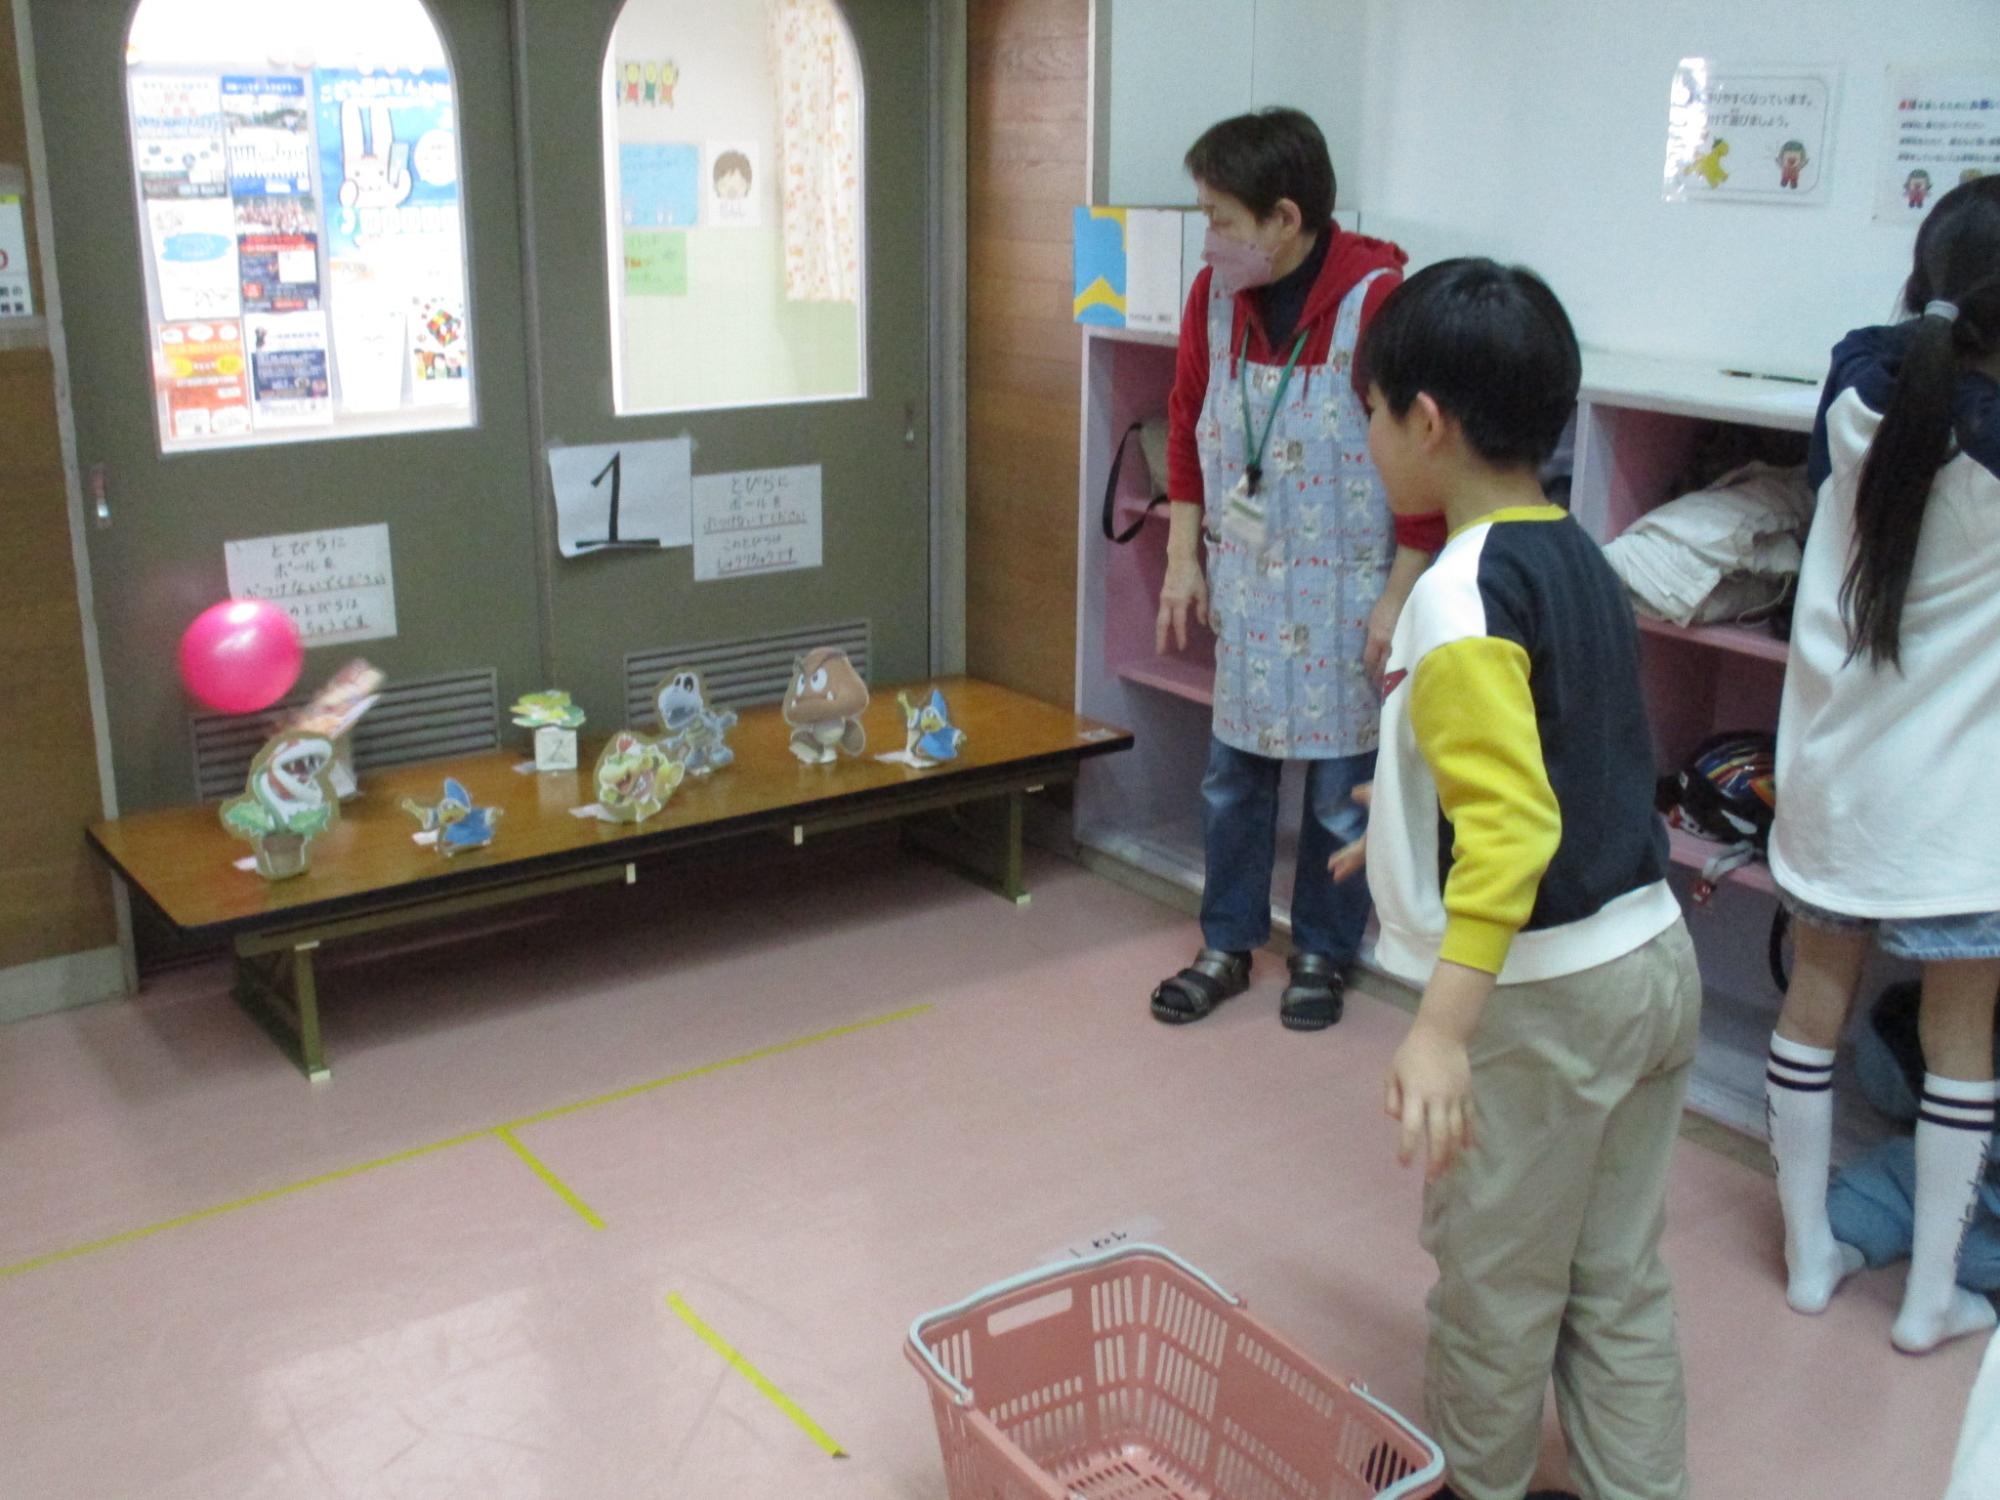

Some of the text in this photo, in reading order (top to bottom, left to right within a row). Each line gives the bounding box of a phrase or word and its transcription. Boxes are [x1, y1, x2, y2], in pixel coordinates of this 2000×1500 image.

[731, 475, 789, 496] とびらに
[576, 451, 661, 549] 1
[729, 495, 782, 511] ボールを
[271, 535, 347, 559] とびらに
[275, 556, 334, 579] ボールを
